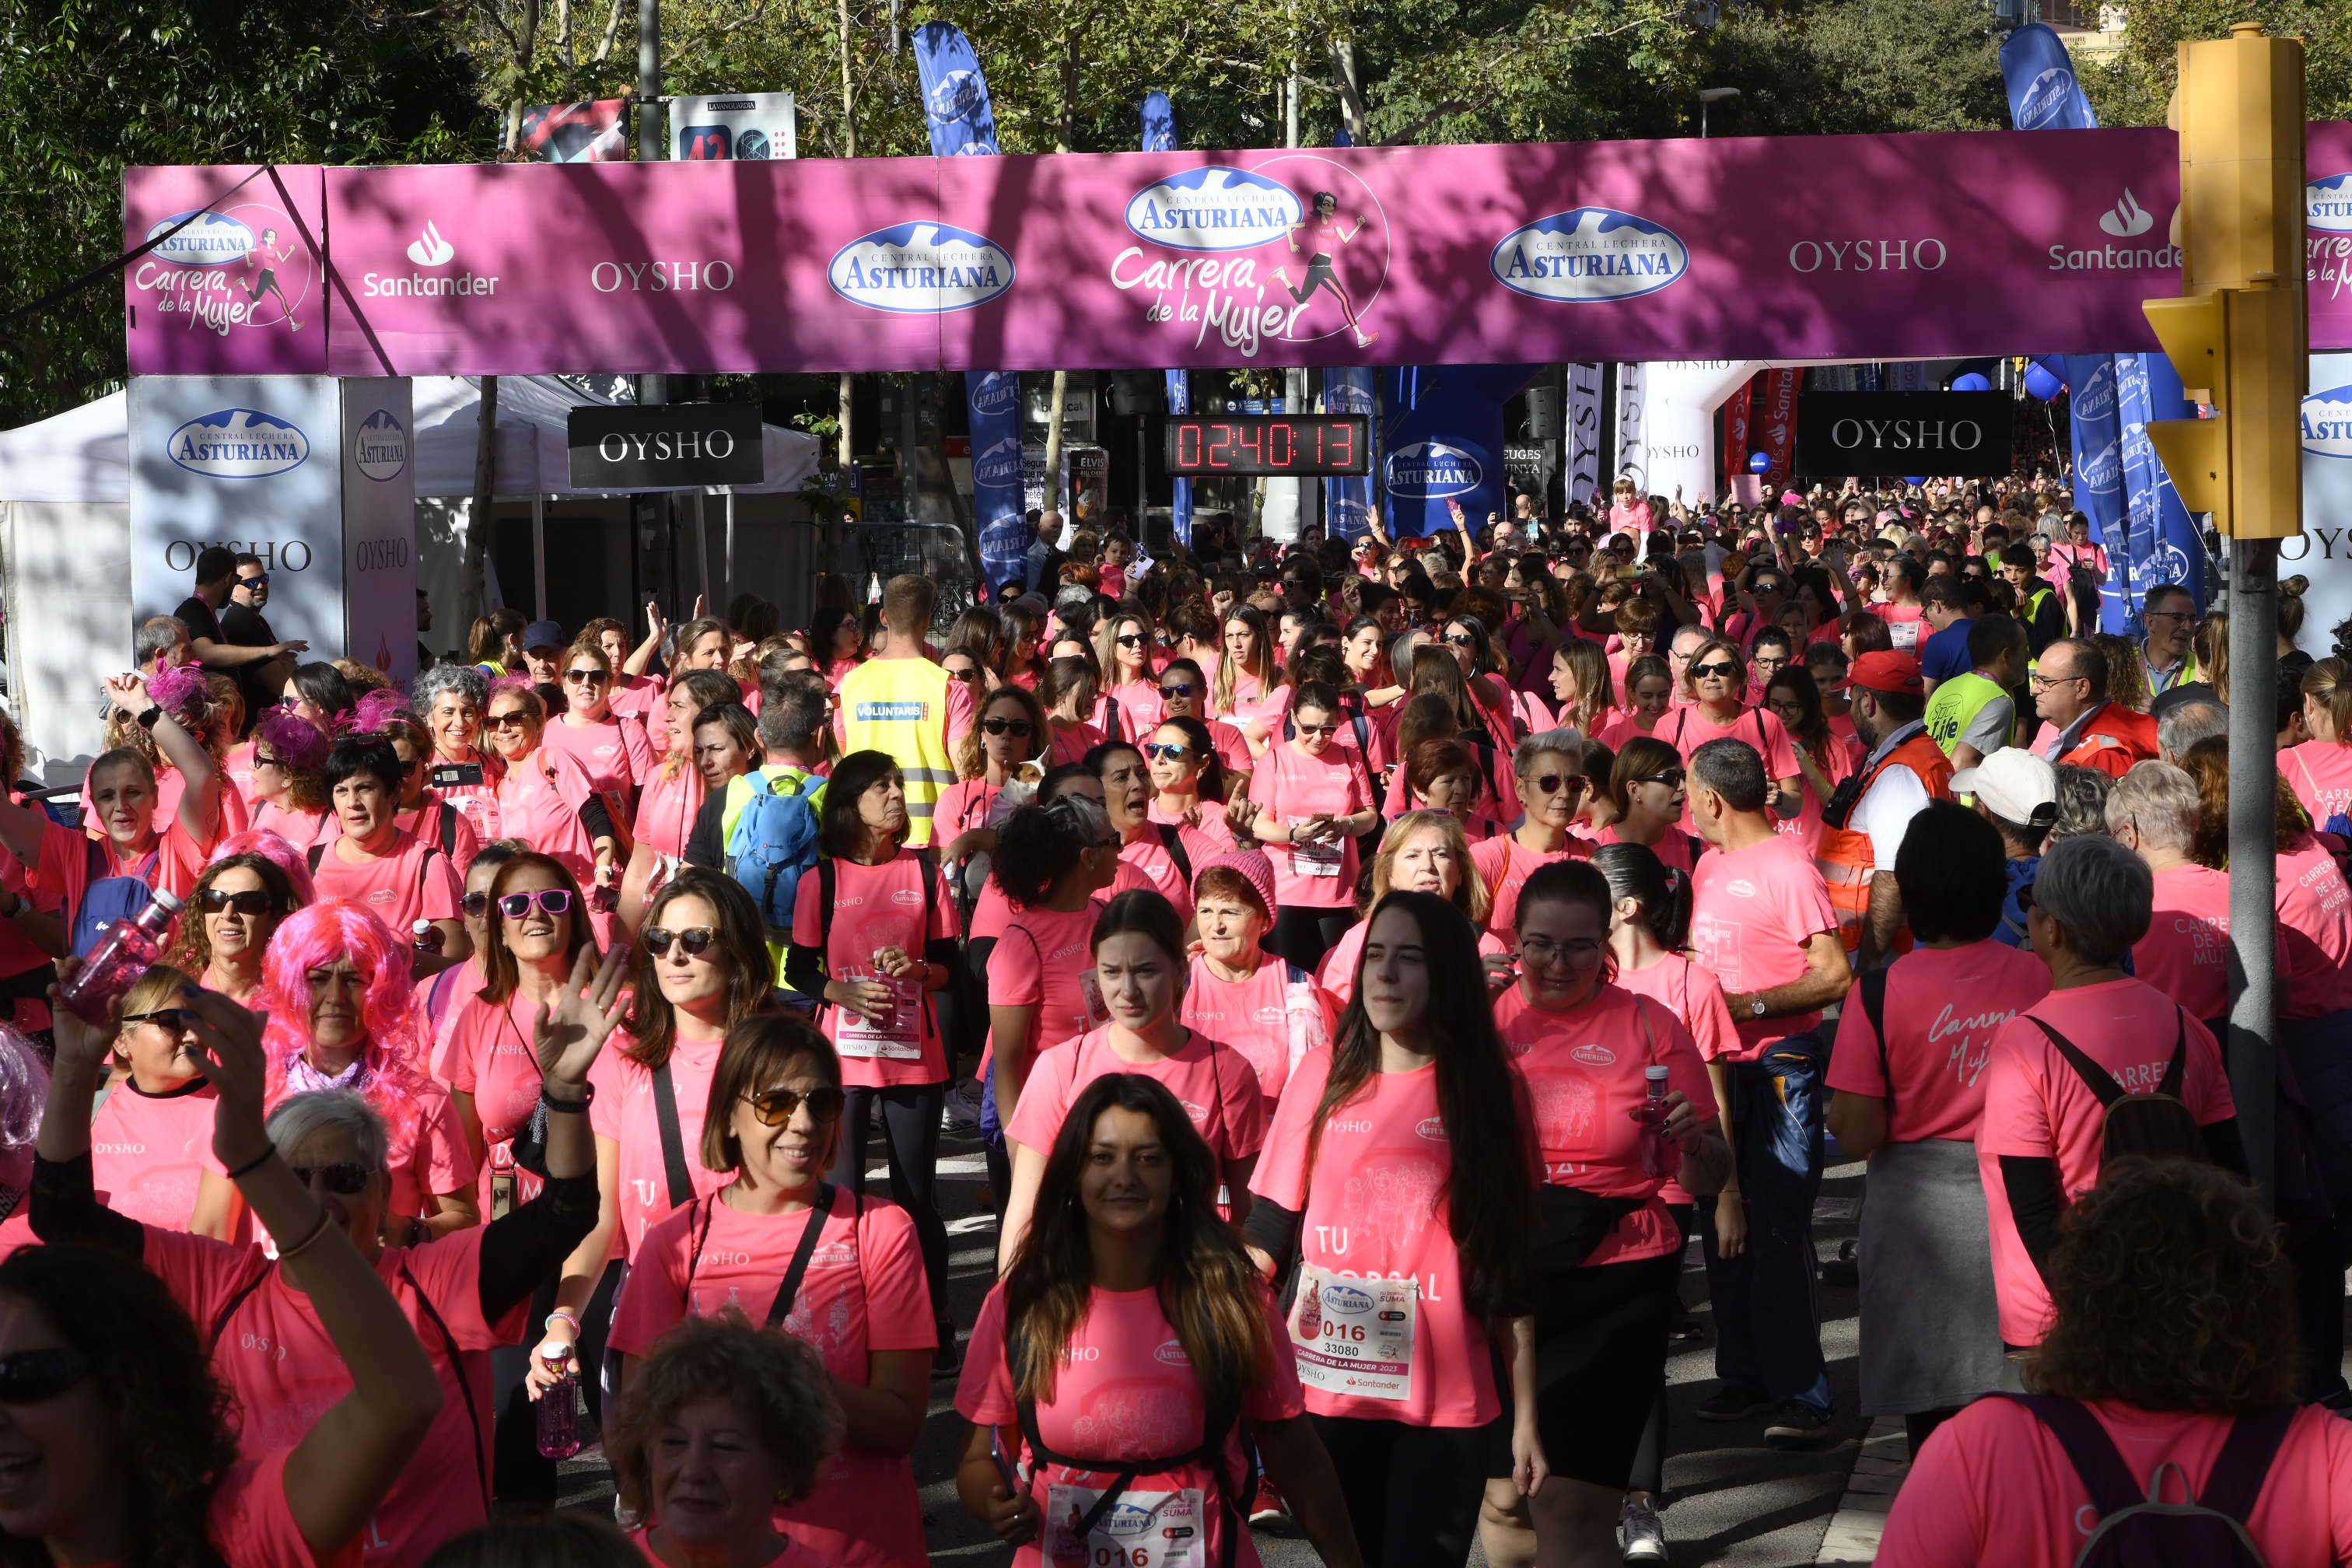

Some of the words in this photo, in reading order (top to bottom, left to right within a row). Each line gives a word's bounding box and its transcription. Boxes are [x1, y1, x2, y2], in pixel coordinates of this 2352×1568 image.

[1167, 194, 1220, 205] CENTRAL
[1139, 198, 1288, 230] ASTURIANA
[1535, 240, 1598, 251] CENTRAL
[1602, 239, 1667, 250] LECHERA
[1789, 238, 1947, 273] OYSHO
[870, 253, 929, 263] CENTRAL
[931, 251, 995, 262] LECHERA
[1111, 247, 1257, 290] Carrera
[1506, 243, 1673, 279] ASTURIANA
[2048, 243, 2182, 271] Santande
[135, 261, 226, 292] Carrera
[591, 260, 734, 292] OYSHO
[842, 255, 1001, 289] ASTURIANA
[2320, 260, 2335, 282] la
[363, 271, 499, 298] Santander
[158, 292, 175, 312] de
[178, 293, 191, 313] la
[188, 288, 262, 337] Mujer
[1146, 291, 1174, 323] de
[1179, 292, 1199, 323] la
[1194, 283, 1311, 359] Mujer
[600, 429, 734, 462] OYSHO
[1178, 423, 1353, 467] 02:40:13
[1832, 419, 1983, 451] OYSHO
[178, 434, 300, 461] ASTURIANA
[359, 436, 404, 464] ASTURIANA
[1080, 457, 1104, 467] ELVIS
[1388, 464, 1475, 486] ASTURIANA
[356, 537, 408, 572] OYSHO
[857, 706, 921, 717] VOLUNTARIS
[2299, 859, 2337, 887] CARRERA
[2315, 883, 2329, 898] DE
[2327, 875, 2341, 888] LA
[2320, 888, 2350, 914] MUJER
[2175, 916, 2229, 934] CARRE
[1052, 942, 1087, 960] OYSHO
[1186, 1010, 1226, 1022] OYSHO
[888, 1045, 916, 1053] Santander
[1573, 1049, 1612, 1062] ASTURIANA
[94, 1143, 146, 1154] OYSHO
[632, 1178, 656, 1207] TU
[1314, 1226, 1349, 1255] TU
[1325, 1292, 1370, 1309] ASTURIANA
[1379, 1294, 1406, 1304] SUMA
[1323, 1321, 1366, 1342] 016
[1297, 1348, 1325, 1364] CARRERA
[1326, 1357, 1337, 1367] DE
[1338, 1360, 1349, 1369] LA
[1349, 1362, 1377, 1371] MUJER
[1324, 1342, 1360, 1358] 33080
[1356, 1377, 1401, 1390] Santander
[1163, 1509, 1192, 1517] SUMA
[1095, 1547, 1149, 1567] 016
